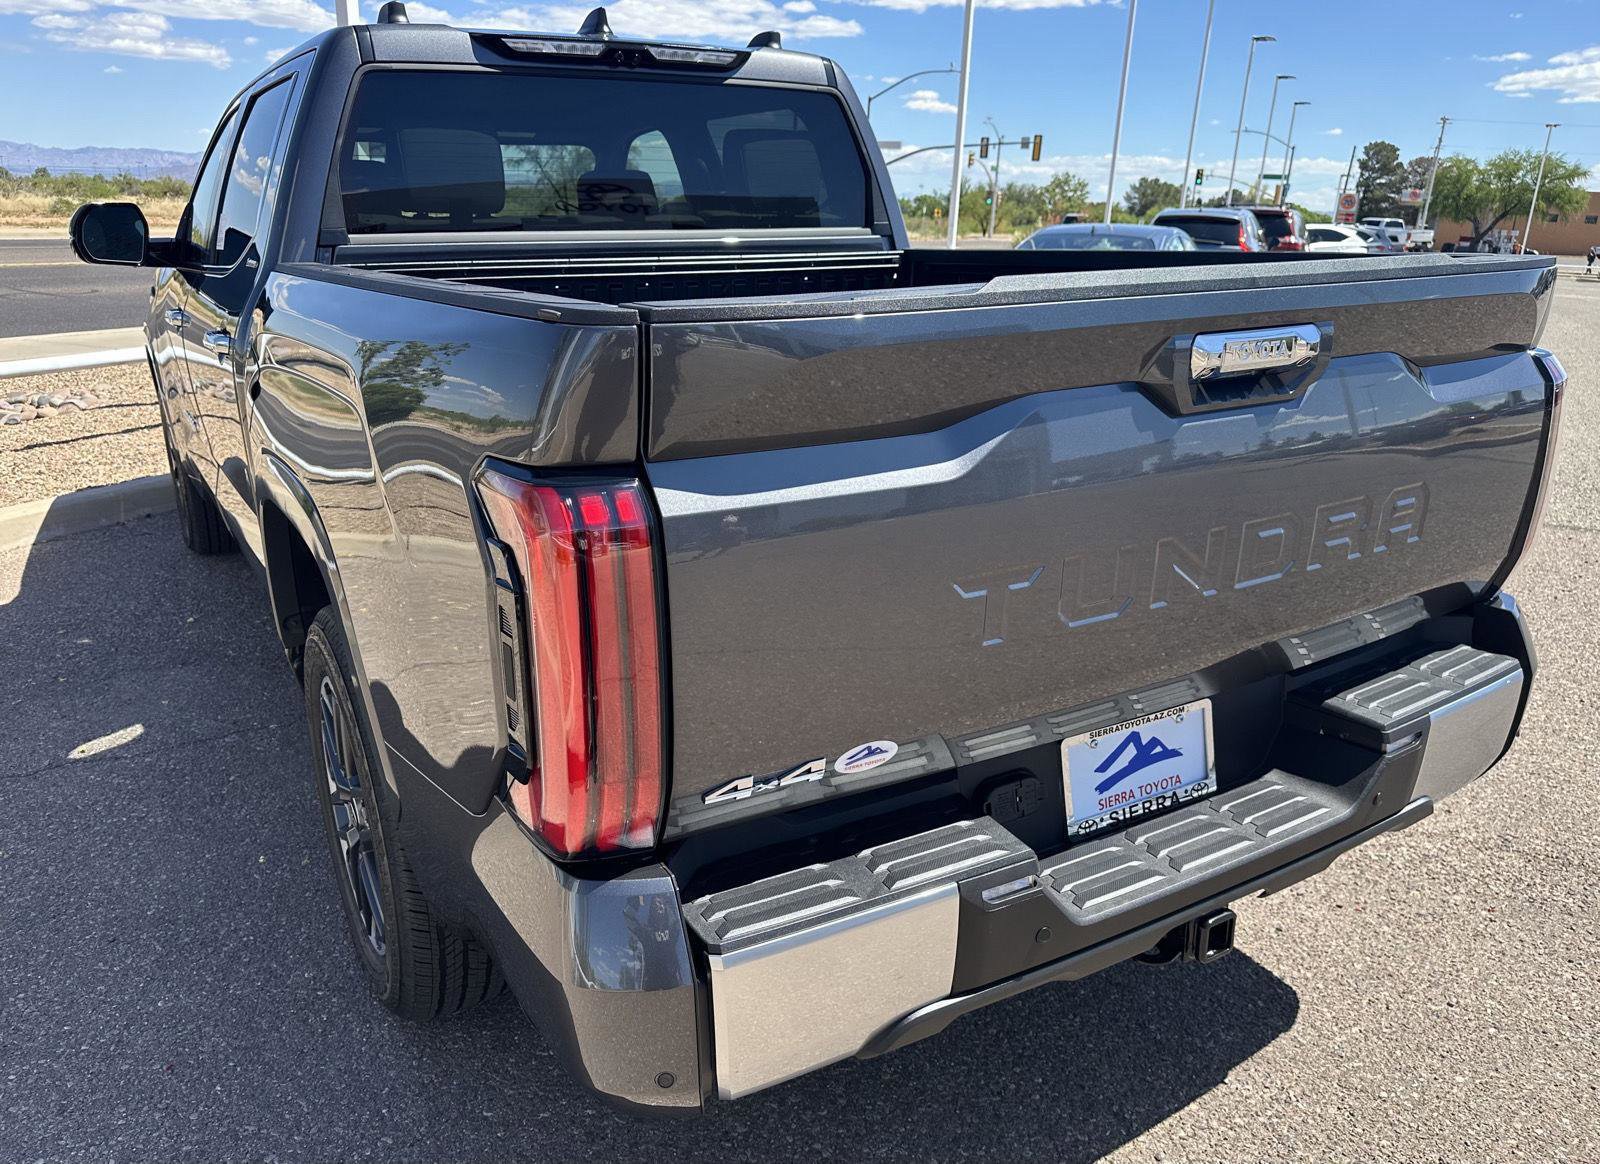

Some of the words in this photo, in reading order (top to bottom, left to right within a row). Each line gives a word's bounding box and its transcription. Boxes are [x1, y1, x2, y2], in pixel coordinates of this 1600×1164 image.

[1231, 339, 1289, 361] TOYOTA
[952, 480, 1431, 646] TUNDRA
[1088, 706, 1185, 740] SIERRATOYOTA-AZ.COM
[1098, 788, 1136, 811] SIERRA
[1139, 773, 1182, 798] TOYOTA
[1108, 790, 1182, 828] SIERRA
